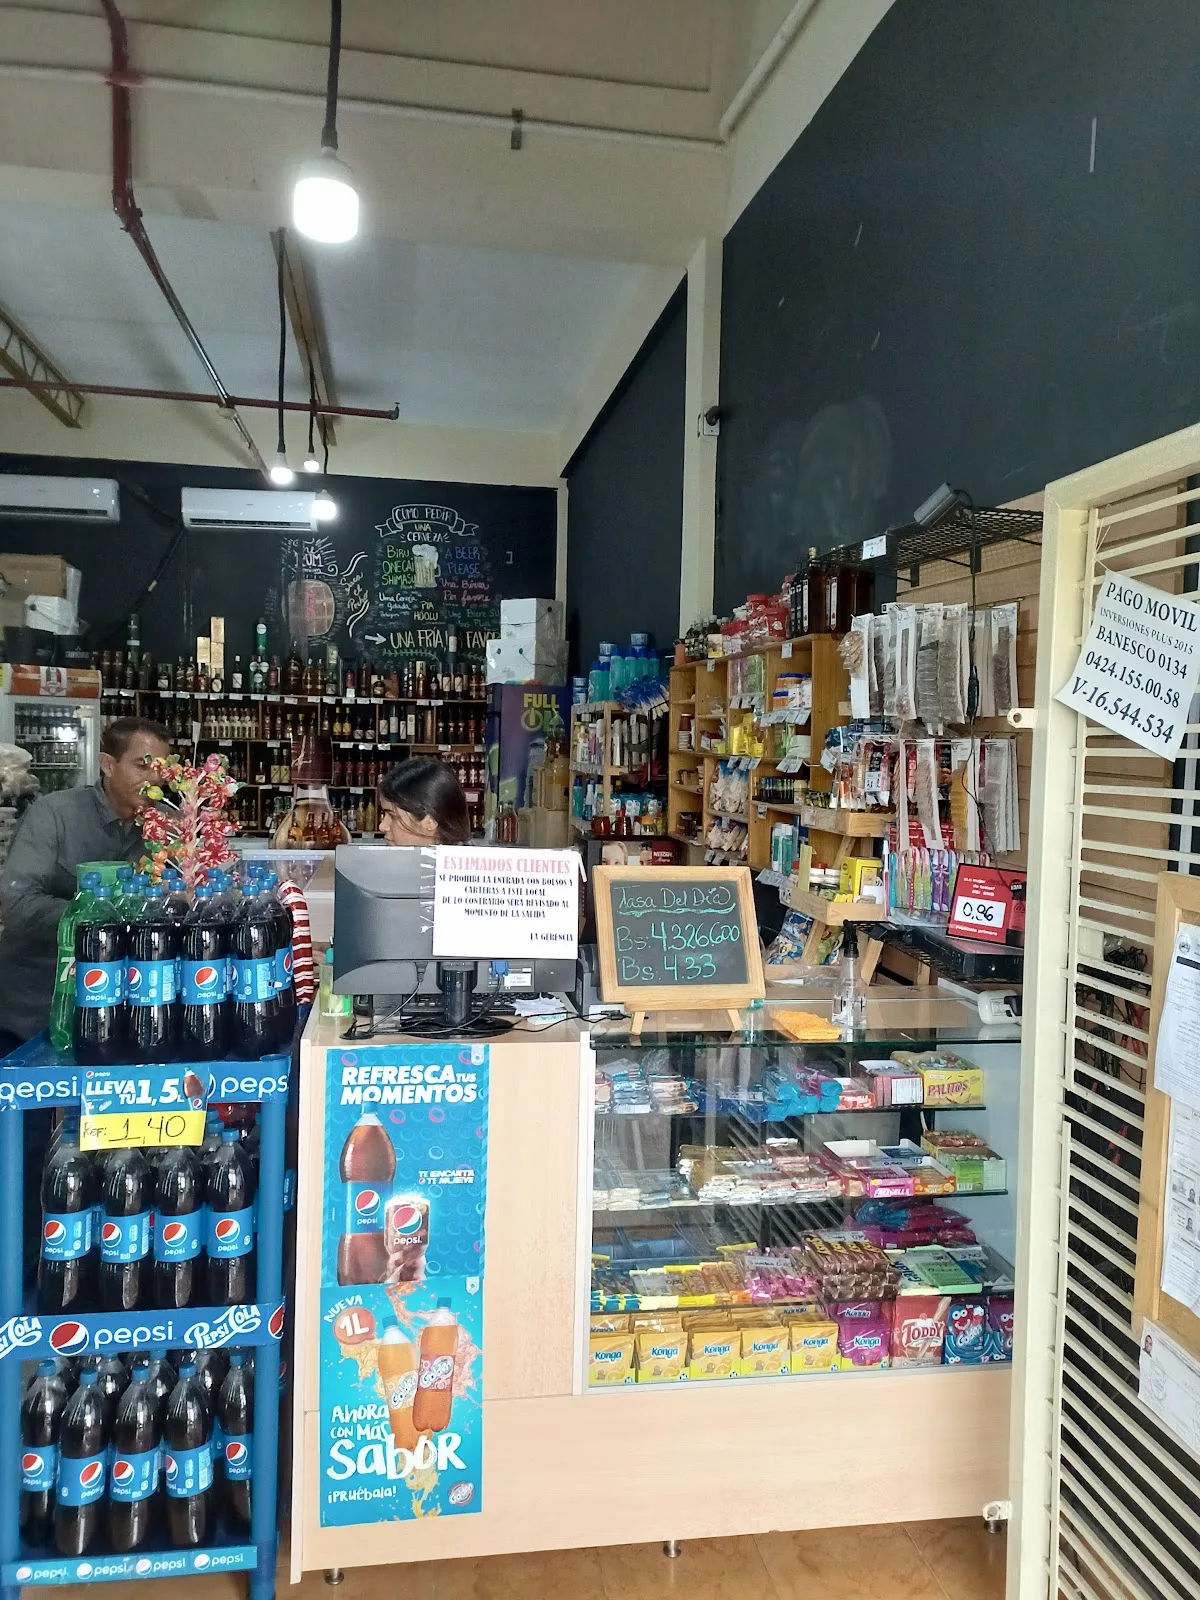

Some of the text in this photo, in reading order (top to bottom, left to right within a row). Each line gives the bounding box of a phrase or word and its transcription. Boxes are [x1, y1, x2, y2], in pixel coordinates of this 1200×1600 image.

[414, 524, 432, 532] UNA
[407, 532, 443, 542] CERVEZA
[445, 546, 480, 560] A BEER
[448, 563, 480, 574] PLEASE
[1106, 582, 1198, 632] PAGO MOVIL
[1100, 606, 1194, 655] INVERSIONES PLUS 2015
[390, 631, 415, 649] UNA
[1096, 625, 1188, 679] BANESCO 0134
[1086, 650, 1180, 708] 0424.155.00.58
[524, 694, 560, 708] FULL
[1071, 676, 1174, 744] V-16.544.534
[444, 855, 571, 874] ESTIMADOS CLIENTES
[449, 874, 482, 884] PROHIBE
[483, 876, 491, 884] LA
[493, 876, 525, 885] ENTRADA
[464, 886, 499, 894] CARTERAS
[614, 885, 656, 908] Tasa
[660, 887, 688, 908] Del
[465, 897, 504, 906] CONTRARIO
[507, 898, 524, 906] SERA
[526, 899, 559, 908] REVISADO
[464, 908, 498, 917] MOMENTO
[500, 909, 508, 917] DE
[541, 933, 573, 942] GERENCIA
[664, 954, 717, 980] 4.33
[342, 1064, 476, 1085] REFRESCA TUS
[0, 1076, 78, 1104] pepsi
[86, 1080, 136, 1096] LLEVA
[221, 1075, 288, 1098] peps
[928, 1080, 969, 1096] PALITOS
[340, 1084, 478, 1105] MOMENTOS
[394, 1236, 421, 1246] pepsi
[102, 1248, 119, 1256] pepsi
[217, 1244, 239, 1252] pepsi
[323, 1294, 363, 1324] NUEVA
[340, 1312, 369, 1337] 1L
[94, 1321, 174, 1350] pepsi
[753, 1342, 778, 1352] Konga
[803, 1338, 828, 1347] Konga
[854, 1337, 880, 1348] Konga
[595, 1351, 622, 1362] Konga
[652, 1347, 678, 1358] Konga
[704, 1344, 730, 1356] Konga
[81, 1488, 100, 1499] pepsi
[113, 1487, 131, 1495] pepsi
[153, 1559, 186, 1572] pepsi
[211, 1554, 243, 1566] pepsi
[34, 1568, 66, 1580] pepsi
[94, 1562, 127, 1576] pepsi
